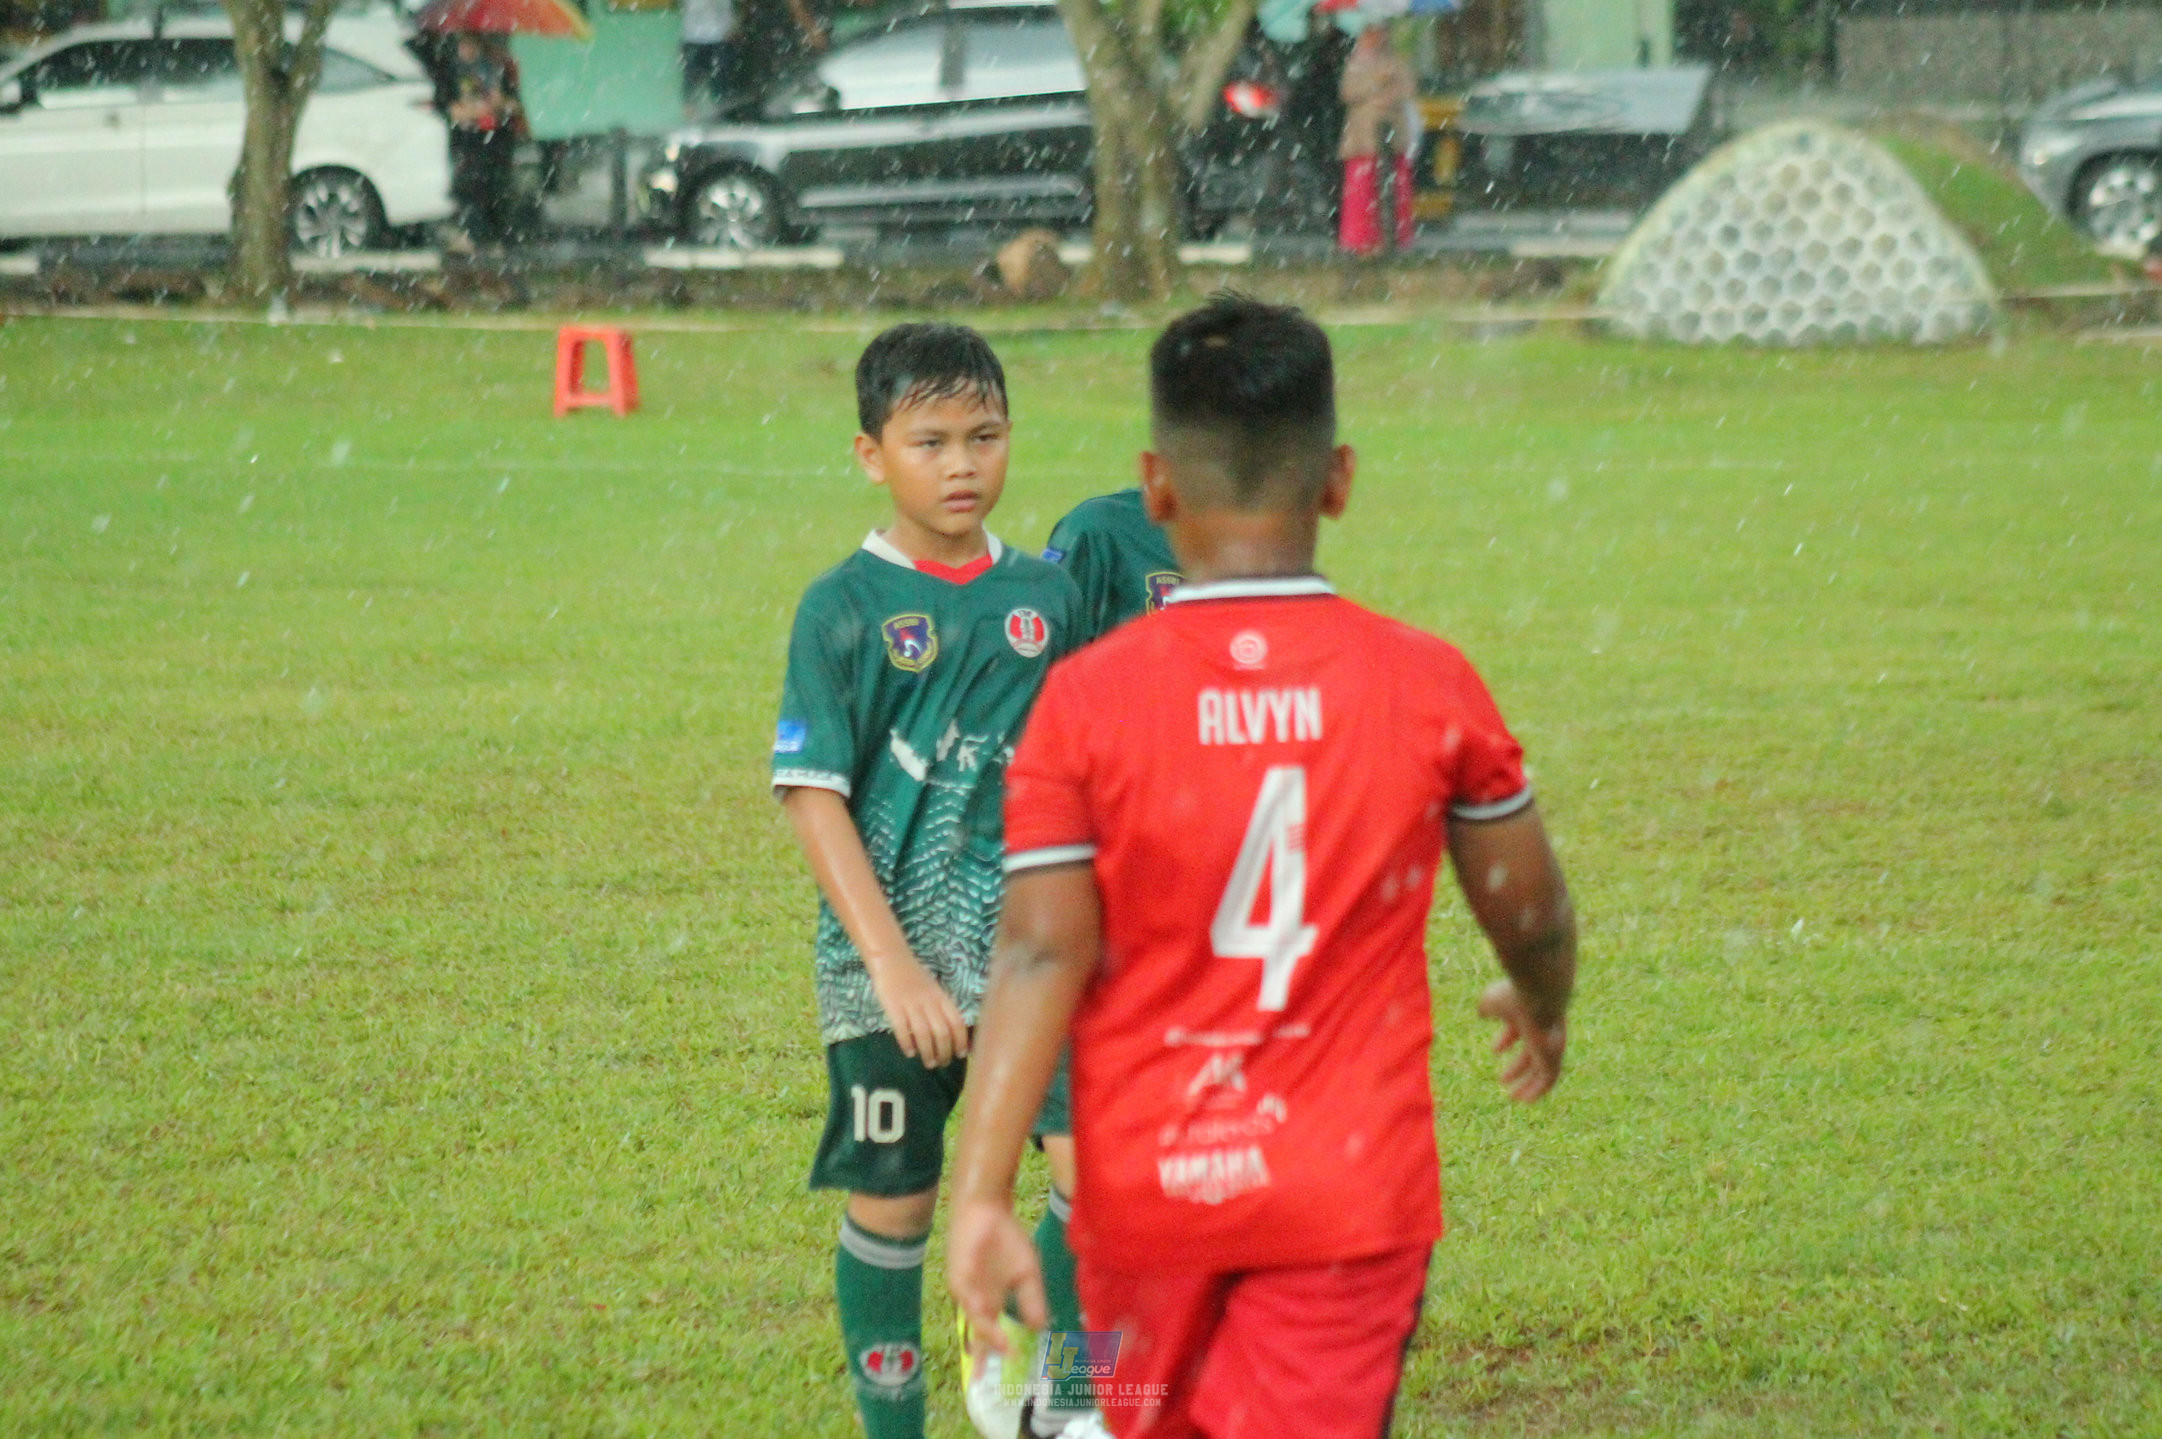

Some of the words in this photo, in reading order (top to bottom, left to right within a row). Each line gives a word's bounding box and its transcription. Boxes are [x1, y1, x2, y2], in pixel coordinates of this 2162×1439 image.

[1199, 687, 1322, 745] ALVYN
[1209, 765, 1318, 1012] 4
[851, 1084, 905, 1143] 10
